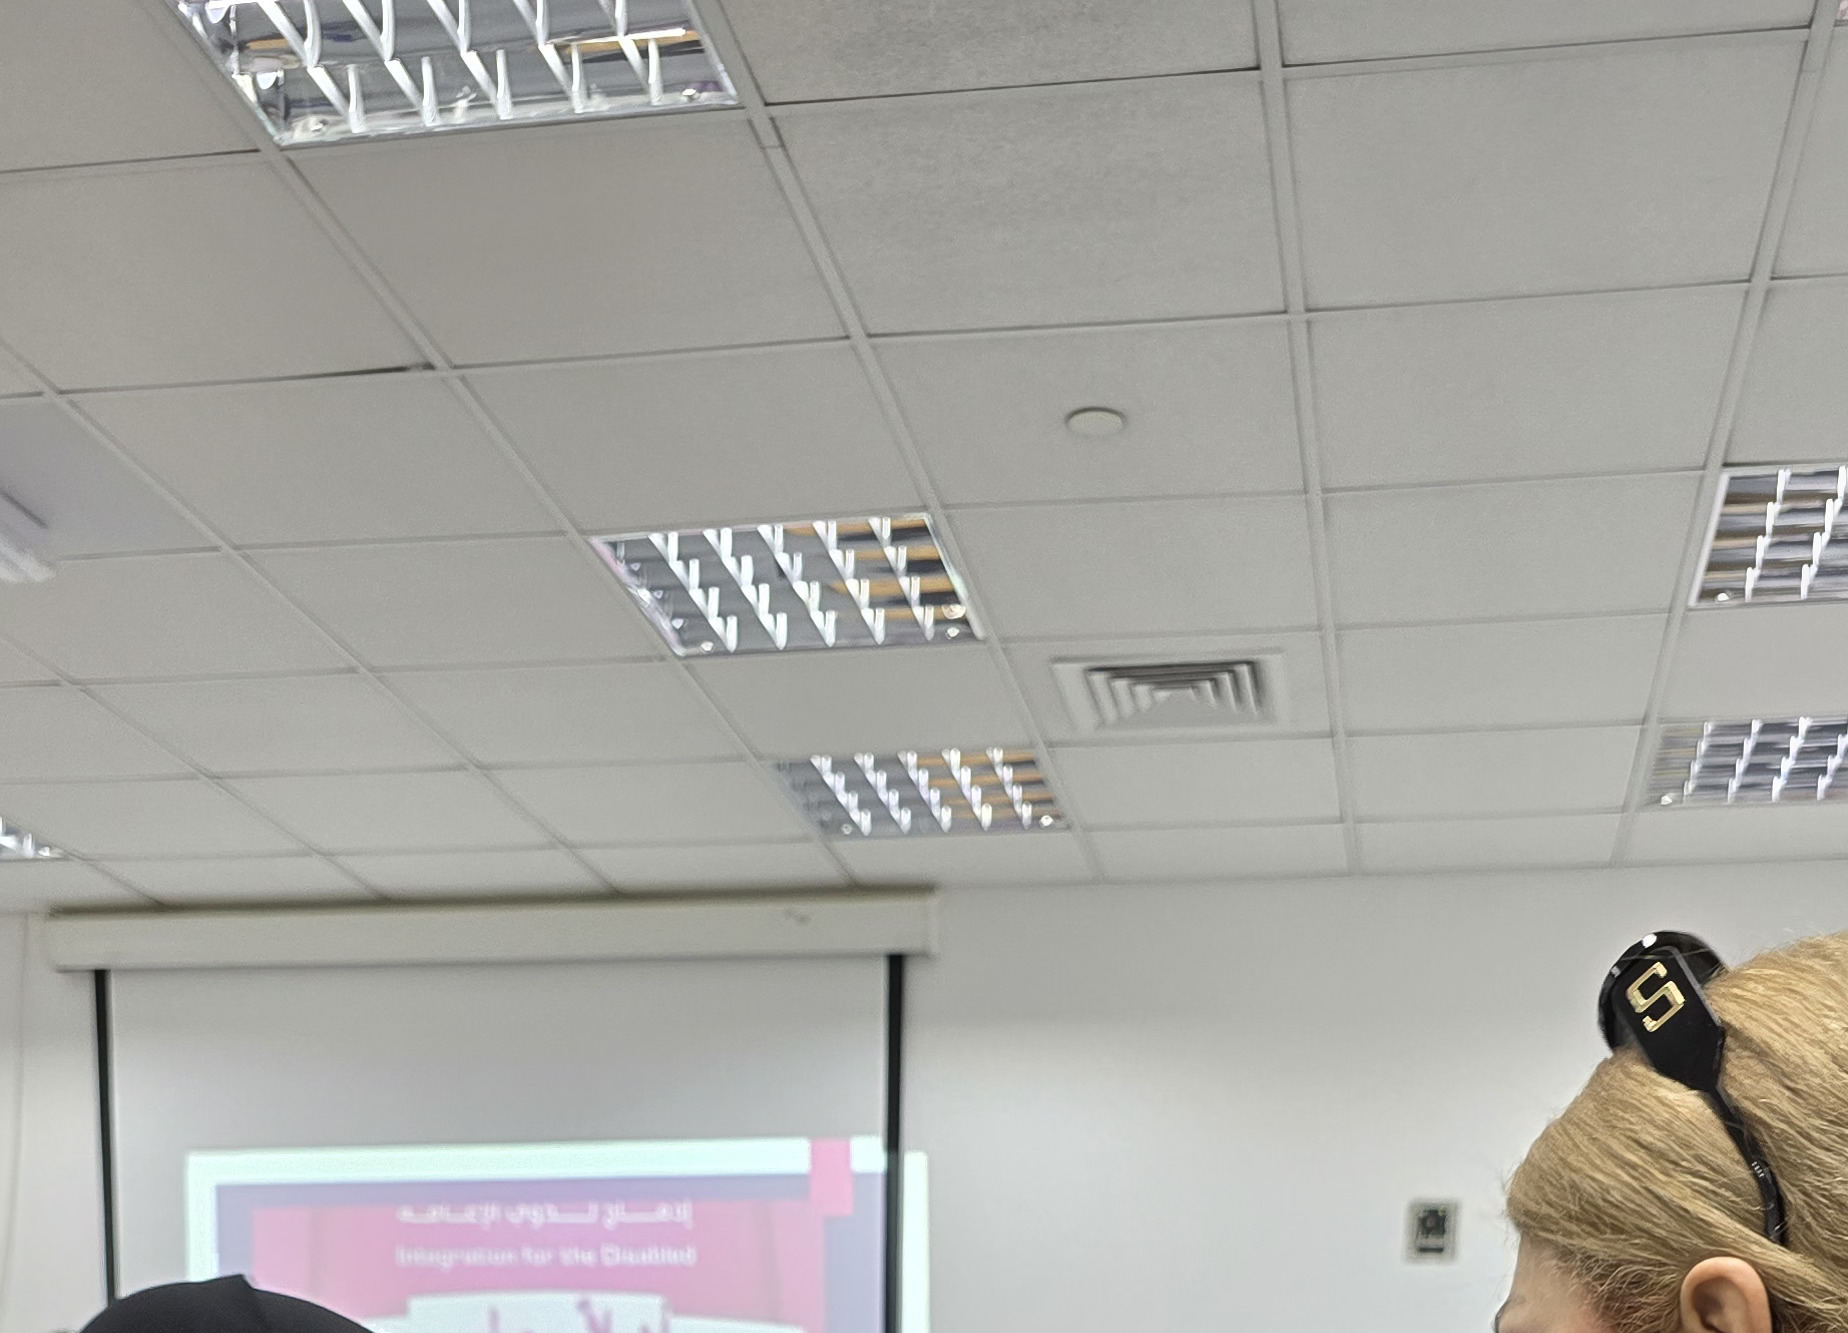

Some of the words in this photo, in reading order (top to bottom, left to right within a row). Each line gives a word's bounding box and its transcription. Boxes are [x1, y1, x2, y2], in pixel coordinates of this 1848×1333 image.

[396, 1247, 518, 1272] Integration
[520, 1246, 552, 1267] for
[559, 1246, 597, 1267] the
[601, 1244, 697, 1267] Disabled
